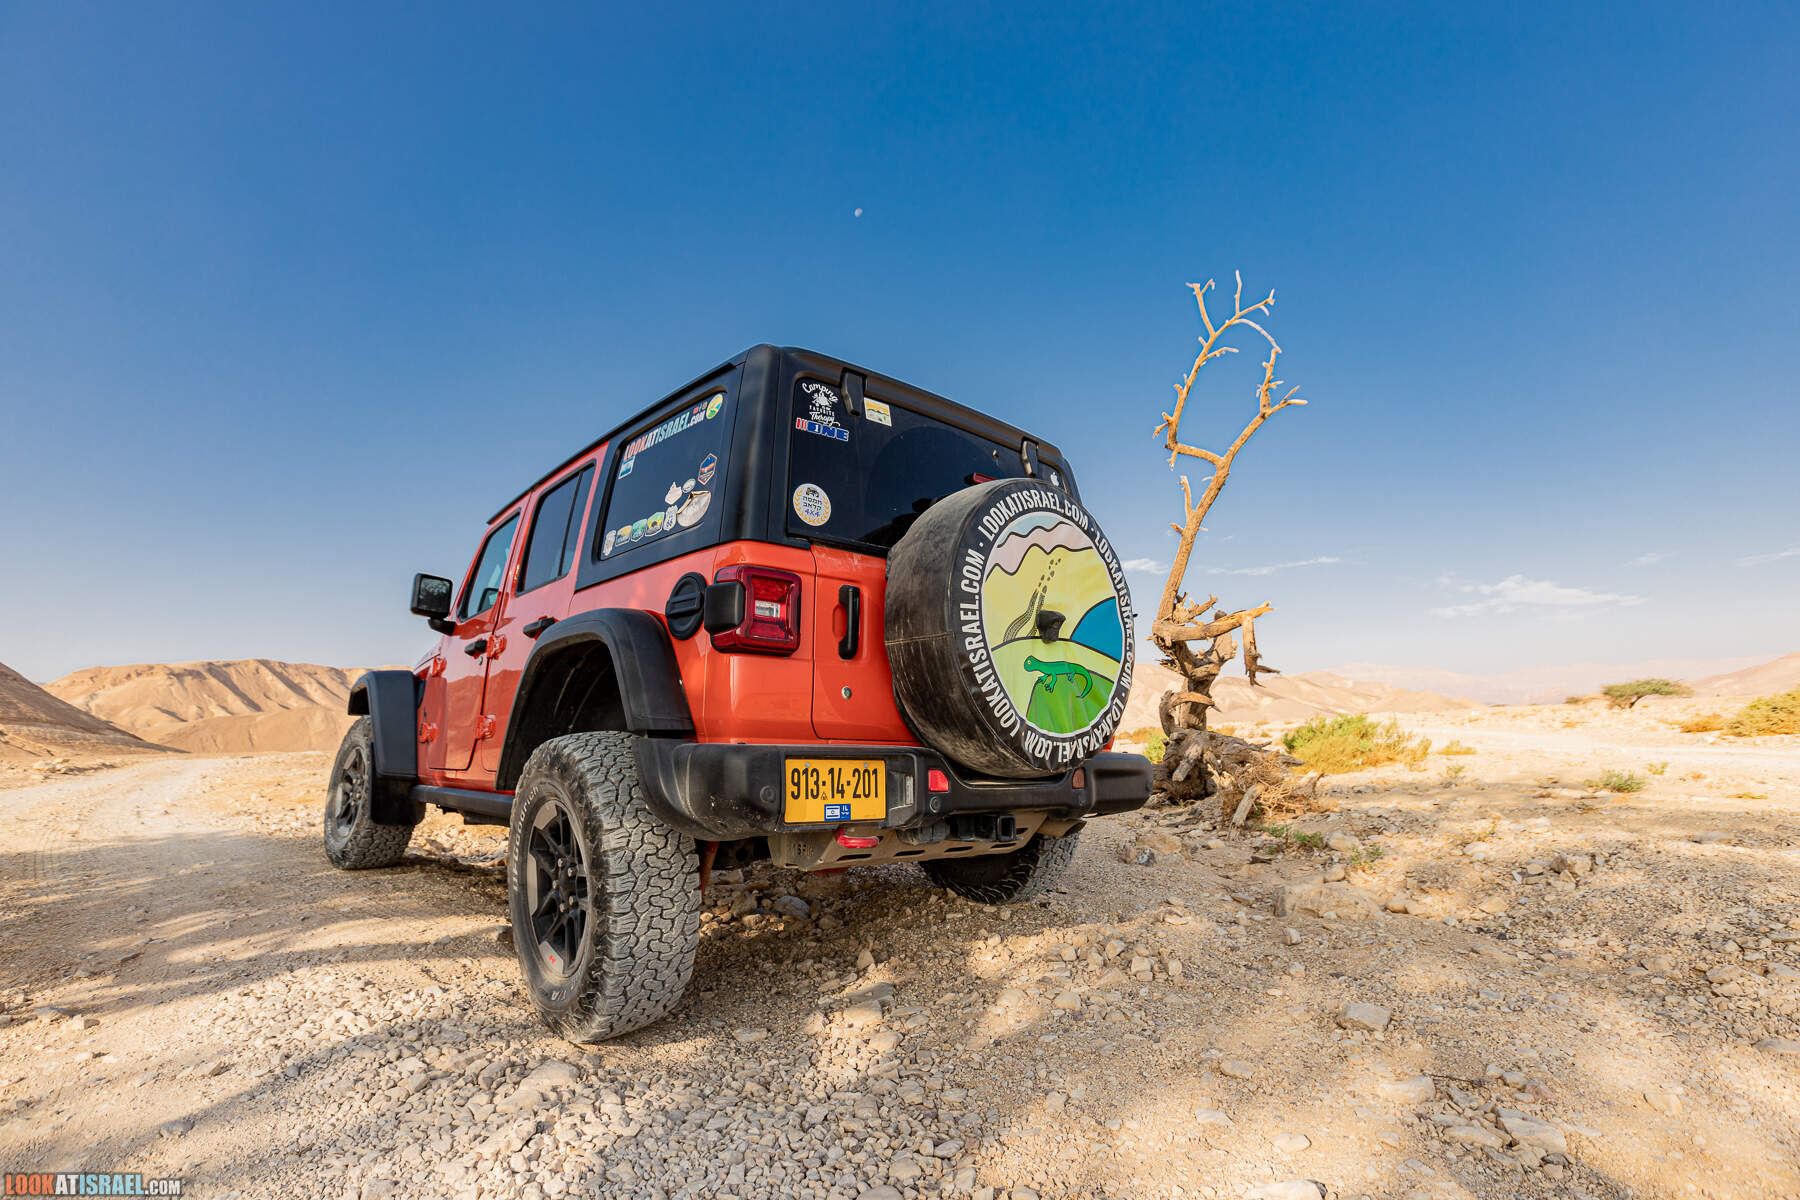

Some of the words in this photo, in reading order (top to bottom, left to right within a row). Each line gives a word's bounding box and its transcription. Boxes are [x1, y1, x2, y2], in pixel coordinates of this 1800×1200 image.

[801, 382, 839, 403] Camping
[977, 489, 1089, 542] LOOKATISRAEL.COM
[960, 548, 1020, 739] LOOKATISRAEL.COM
